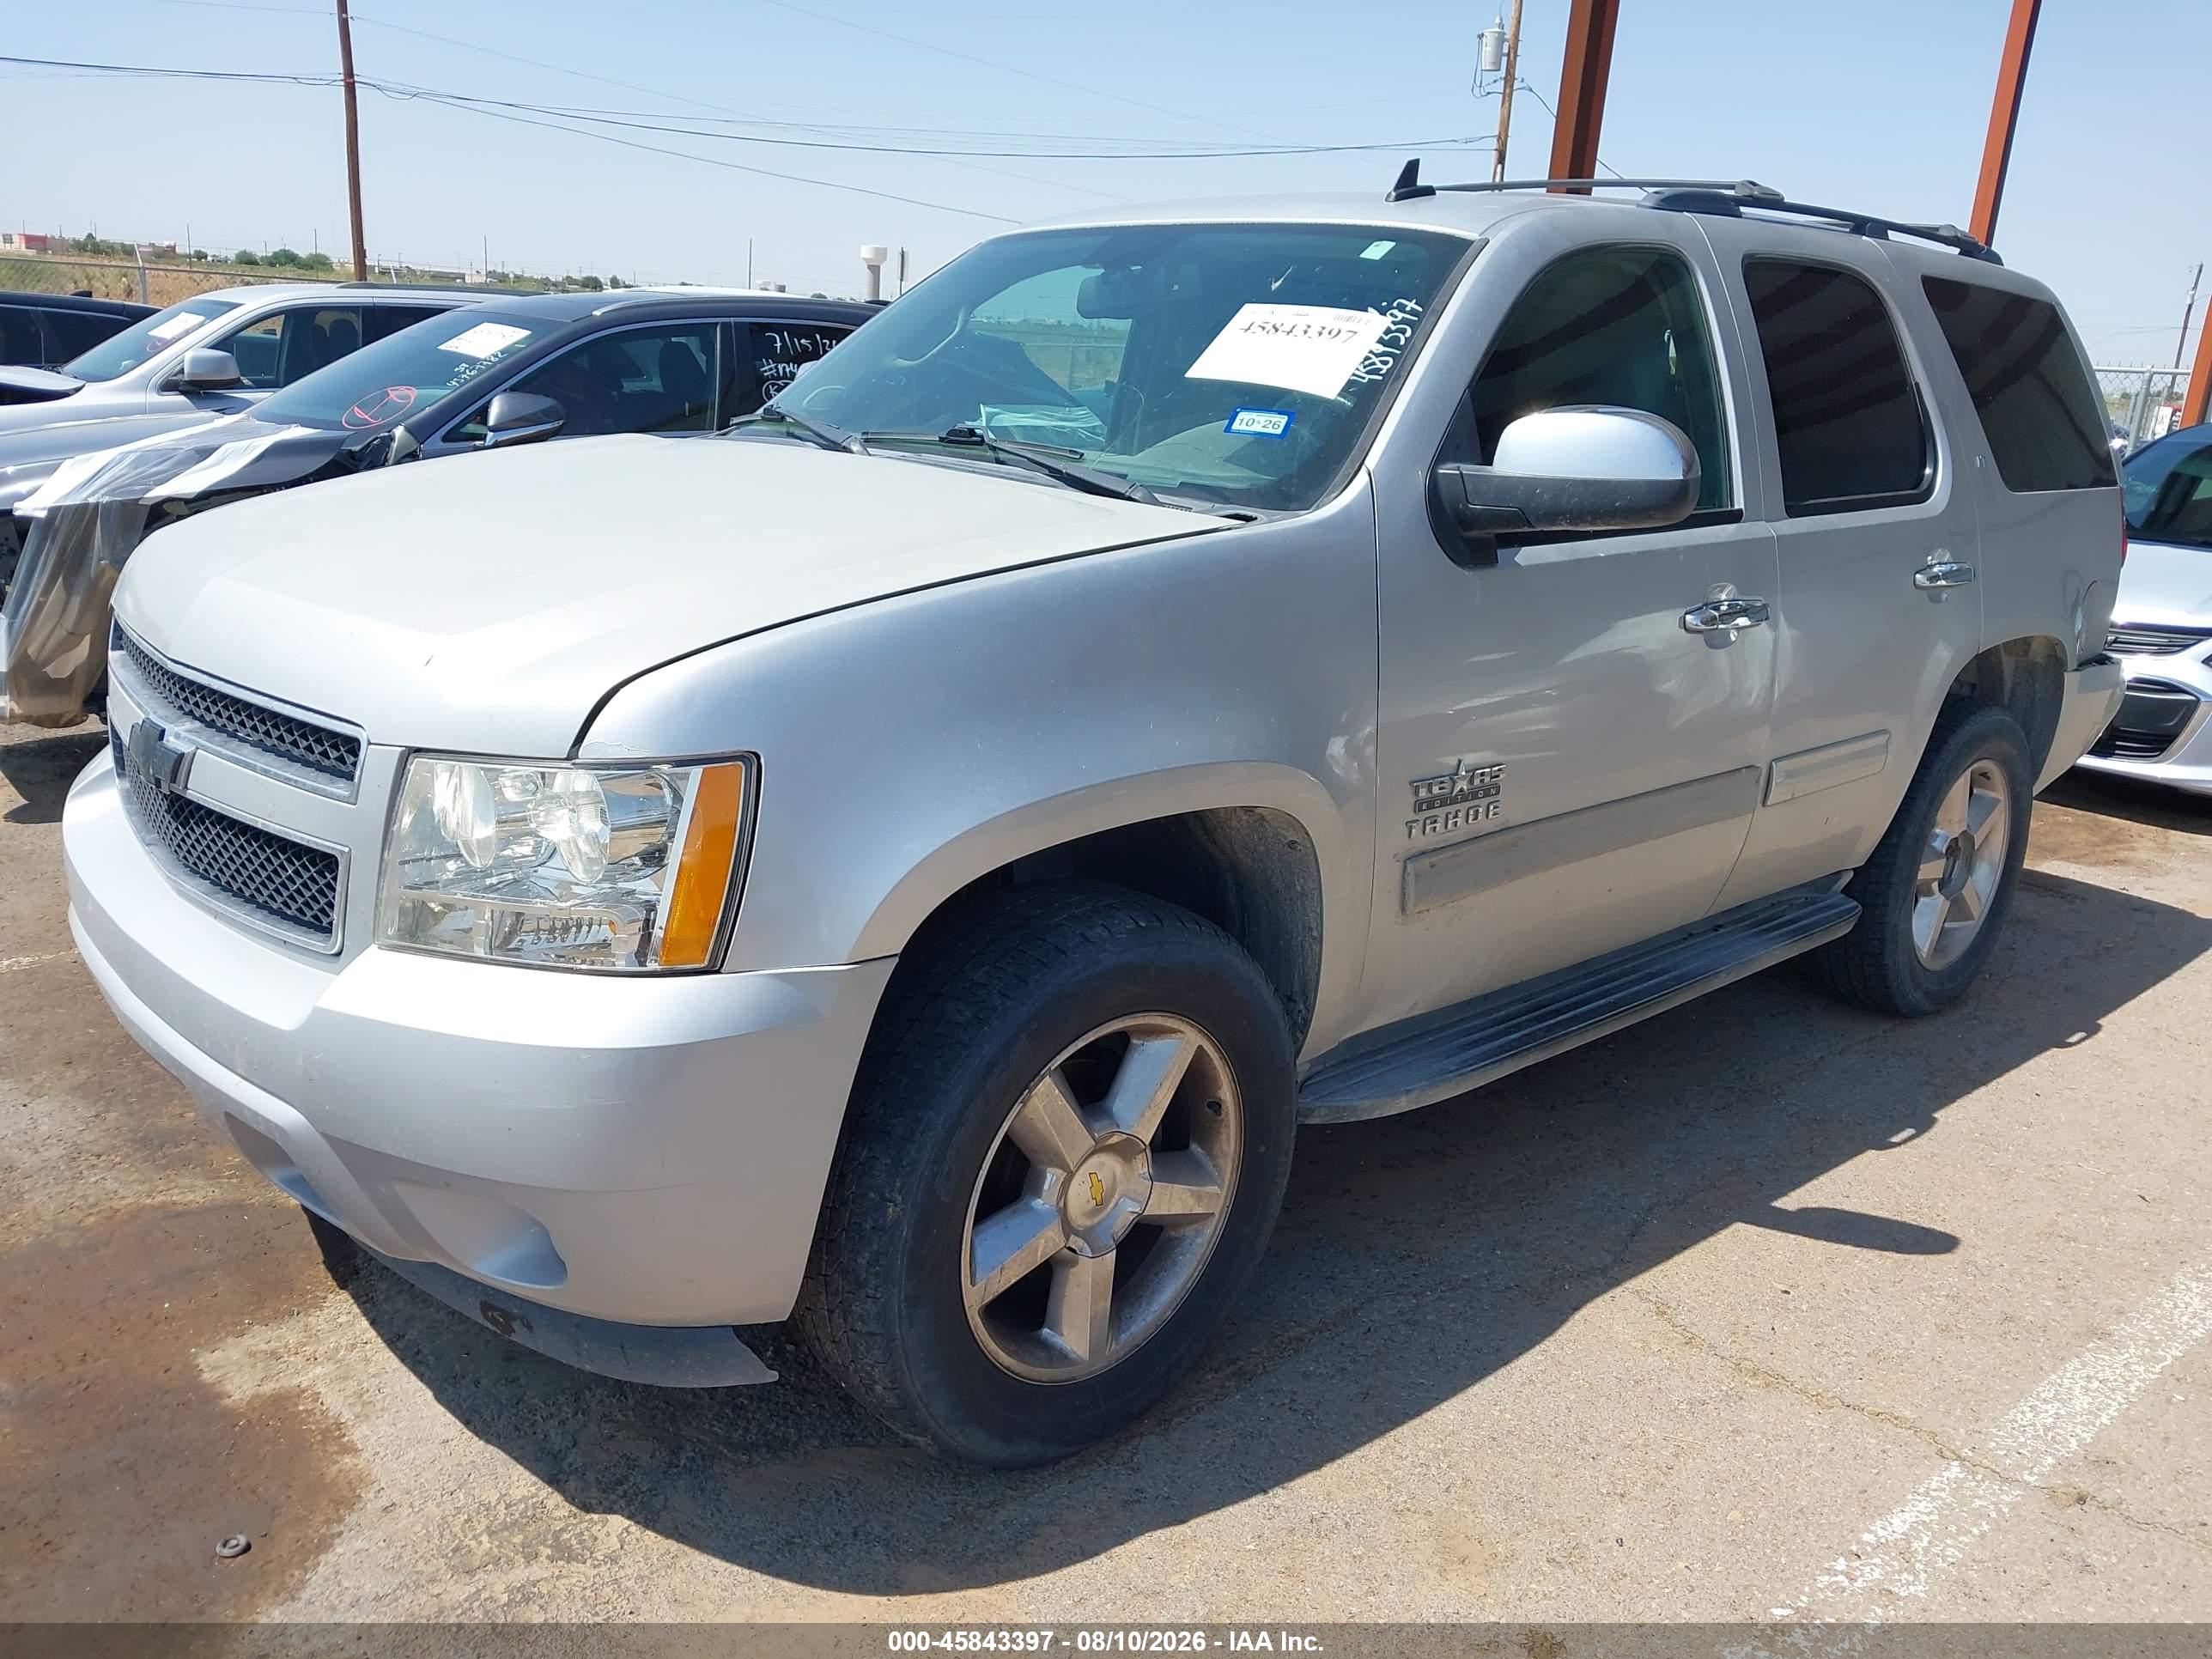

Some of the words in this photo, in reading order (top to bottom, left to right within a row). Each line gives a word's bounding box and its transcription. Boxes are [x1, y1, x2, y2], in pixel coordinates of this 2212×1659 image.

[1239, 321, 1358, 343] 45843397
[1409, 759, 1507, 797] TEXAS
[1422, 787, 1498, 810] EDITION
[1406, 800, 1501, 839] TAHOE
